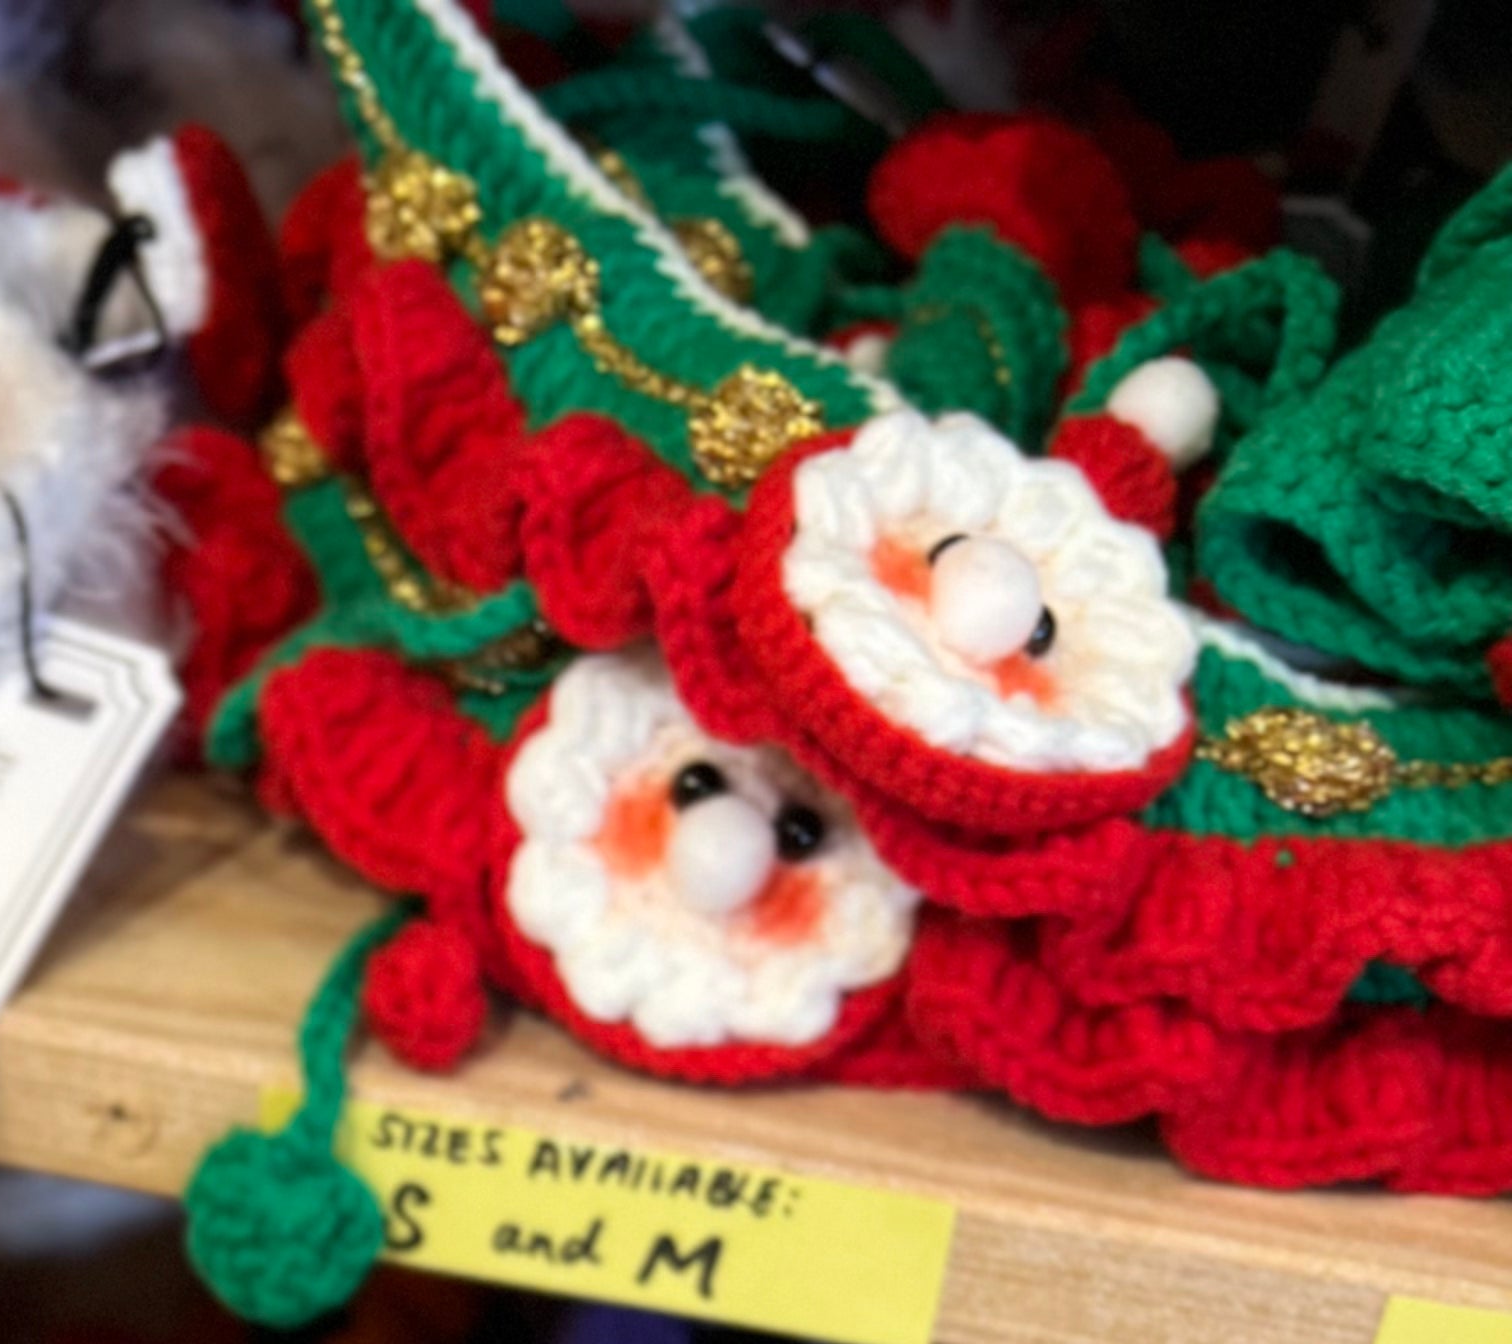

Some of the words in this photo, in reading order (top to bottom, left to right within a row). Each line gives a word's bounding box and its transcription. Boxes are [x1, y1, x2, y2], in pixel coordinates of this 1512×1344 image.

[369, 1111, 503, 1167] SIZES
[384, 1180, 432, 1253] S
[489, 1217, 605, 1266] and
[635, 1232, 724, 1300] M
